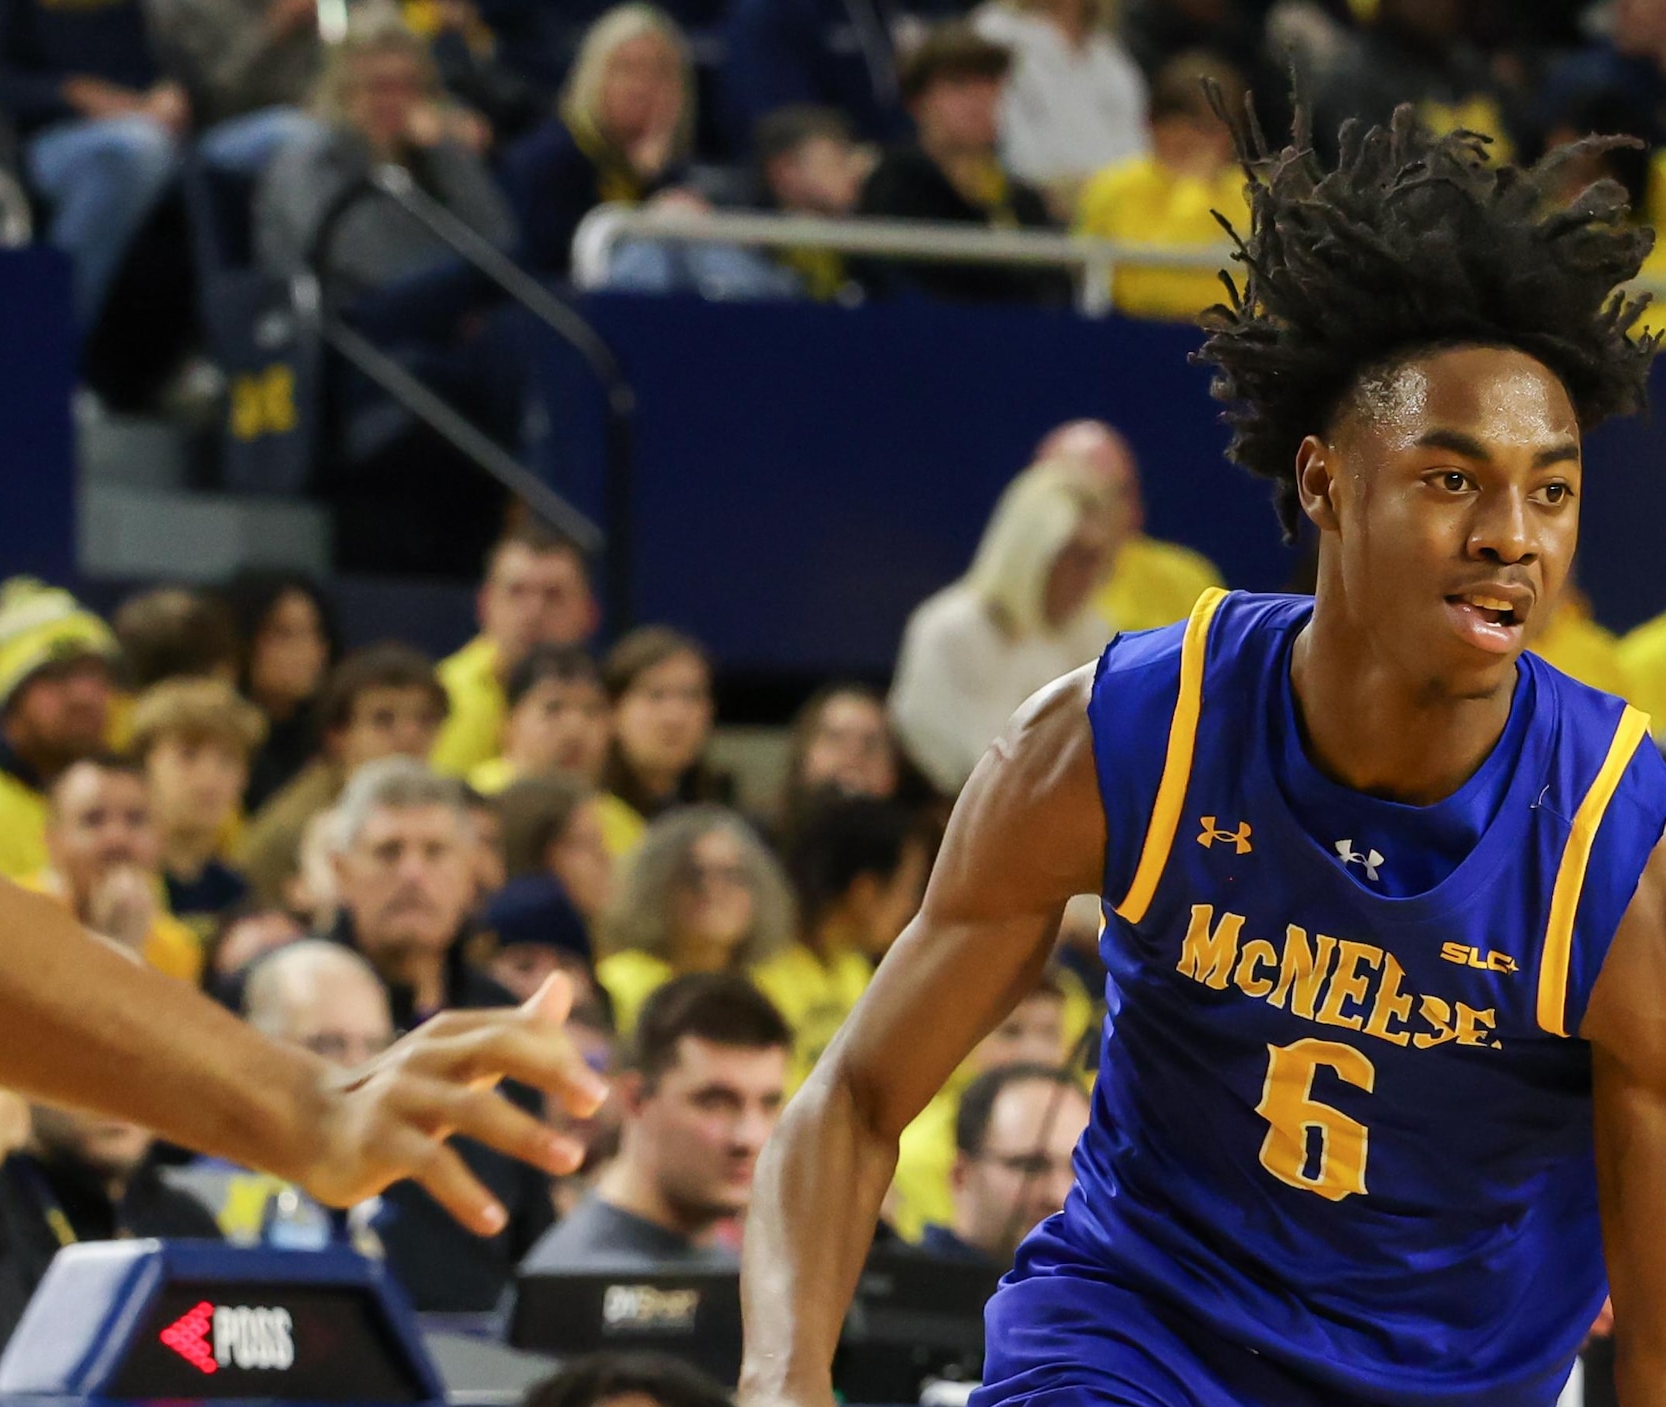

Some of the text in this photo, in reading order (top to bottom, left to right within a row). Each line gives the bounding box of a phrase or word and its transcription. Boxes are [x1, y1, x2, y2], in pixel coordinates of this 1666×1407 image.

[1176, 903, 1504, 1051] McNEESE
[1439, 941, 1519, 976] SLC
[1254, 1037, 1376, 1202] 6
[213, 1304, 296, 1372] POSS
